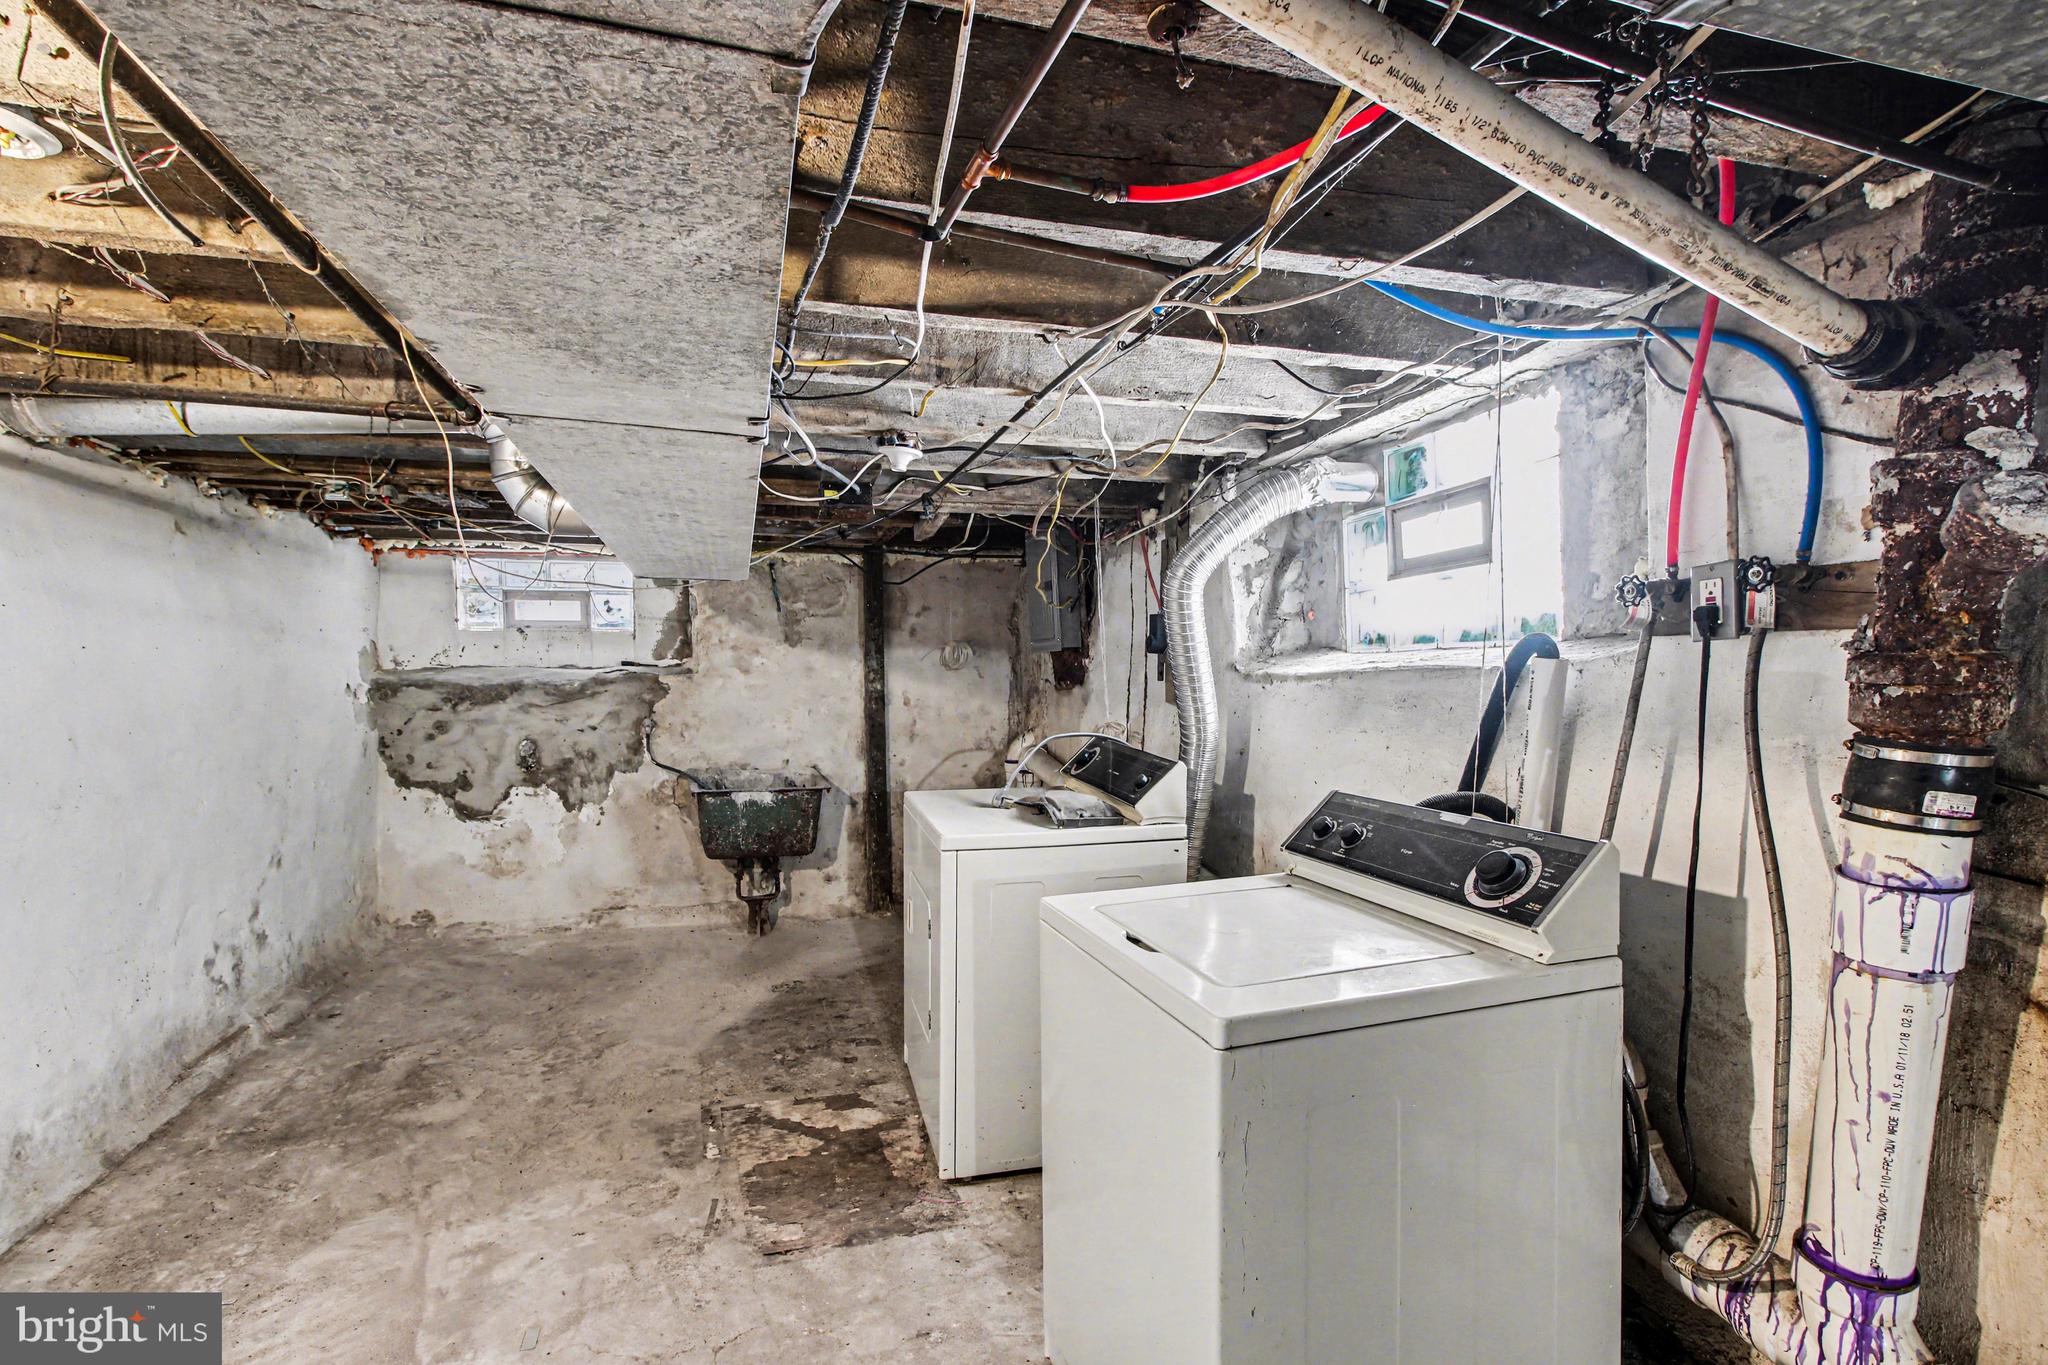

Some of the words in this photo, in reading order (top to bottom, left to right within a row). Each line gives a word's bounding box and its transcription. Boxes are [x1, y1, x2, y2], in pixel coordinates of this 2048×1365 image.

[1895, 1031, 1912, 1071] 01/11/18
[1890, 1101, 1902, 1112] IN
[1887, 1115, 1900, 1136] MADE
